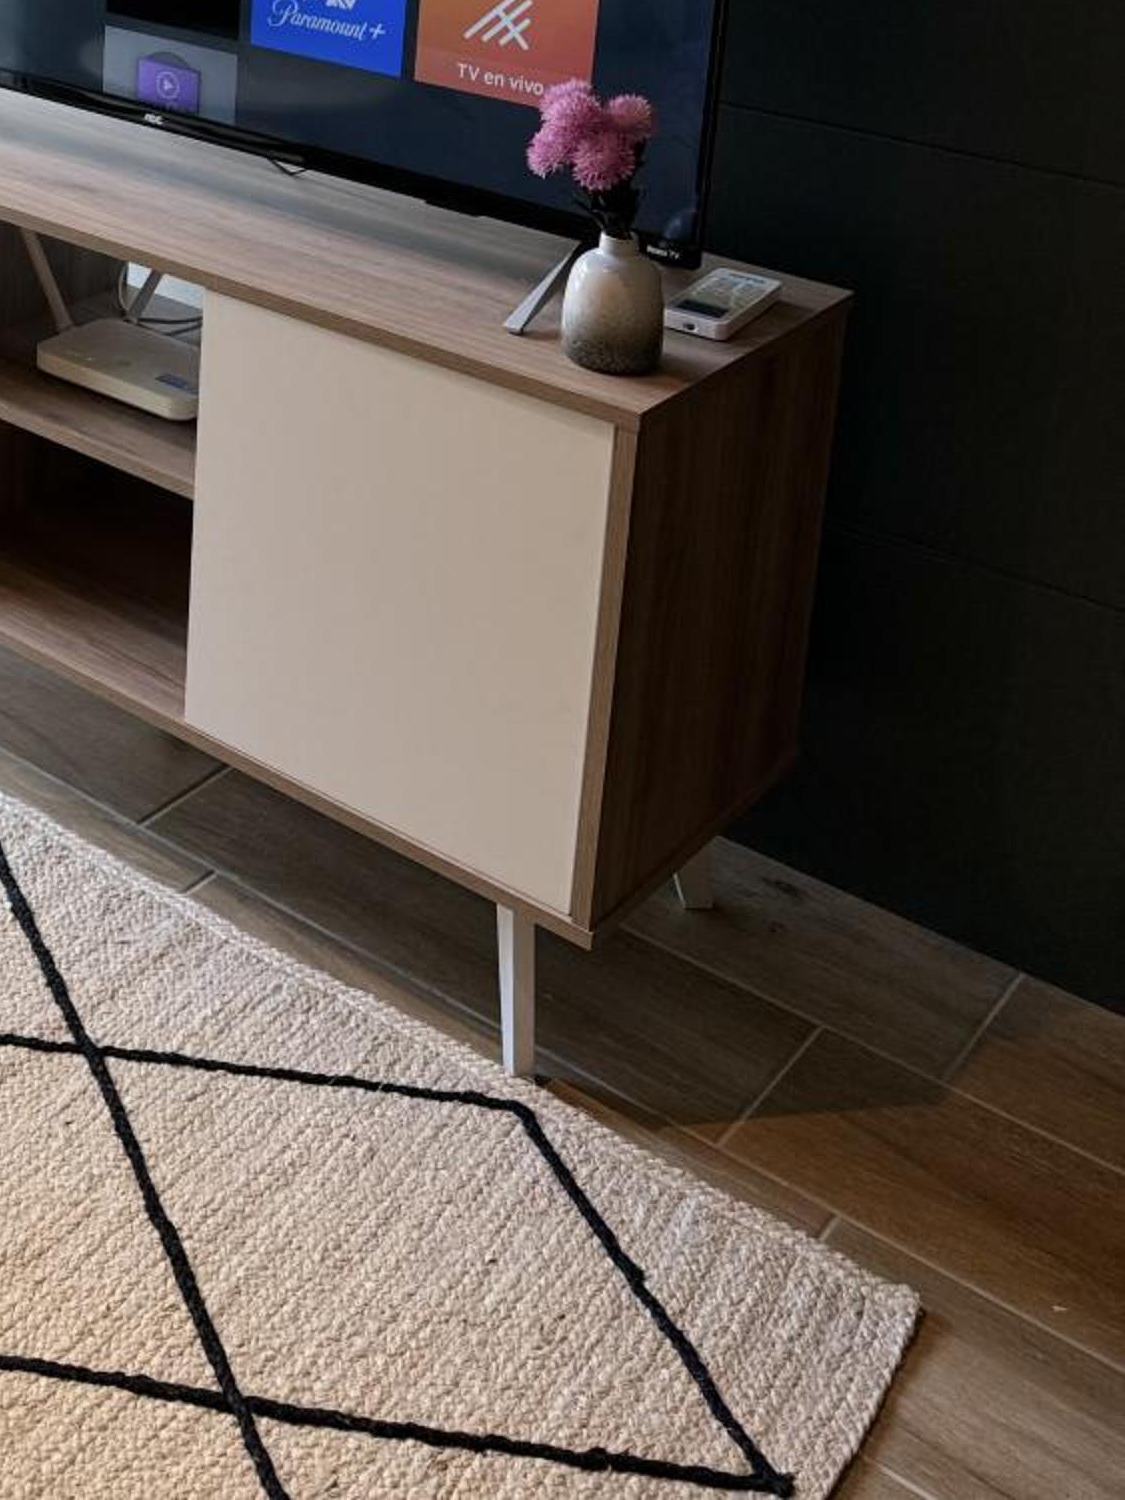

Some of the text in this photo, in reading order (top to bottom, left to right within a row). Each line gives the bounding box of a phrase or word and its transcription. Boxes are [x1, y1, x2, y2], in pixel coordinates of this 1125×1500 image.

[457, 62, 545, 97] TV en vivo
